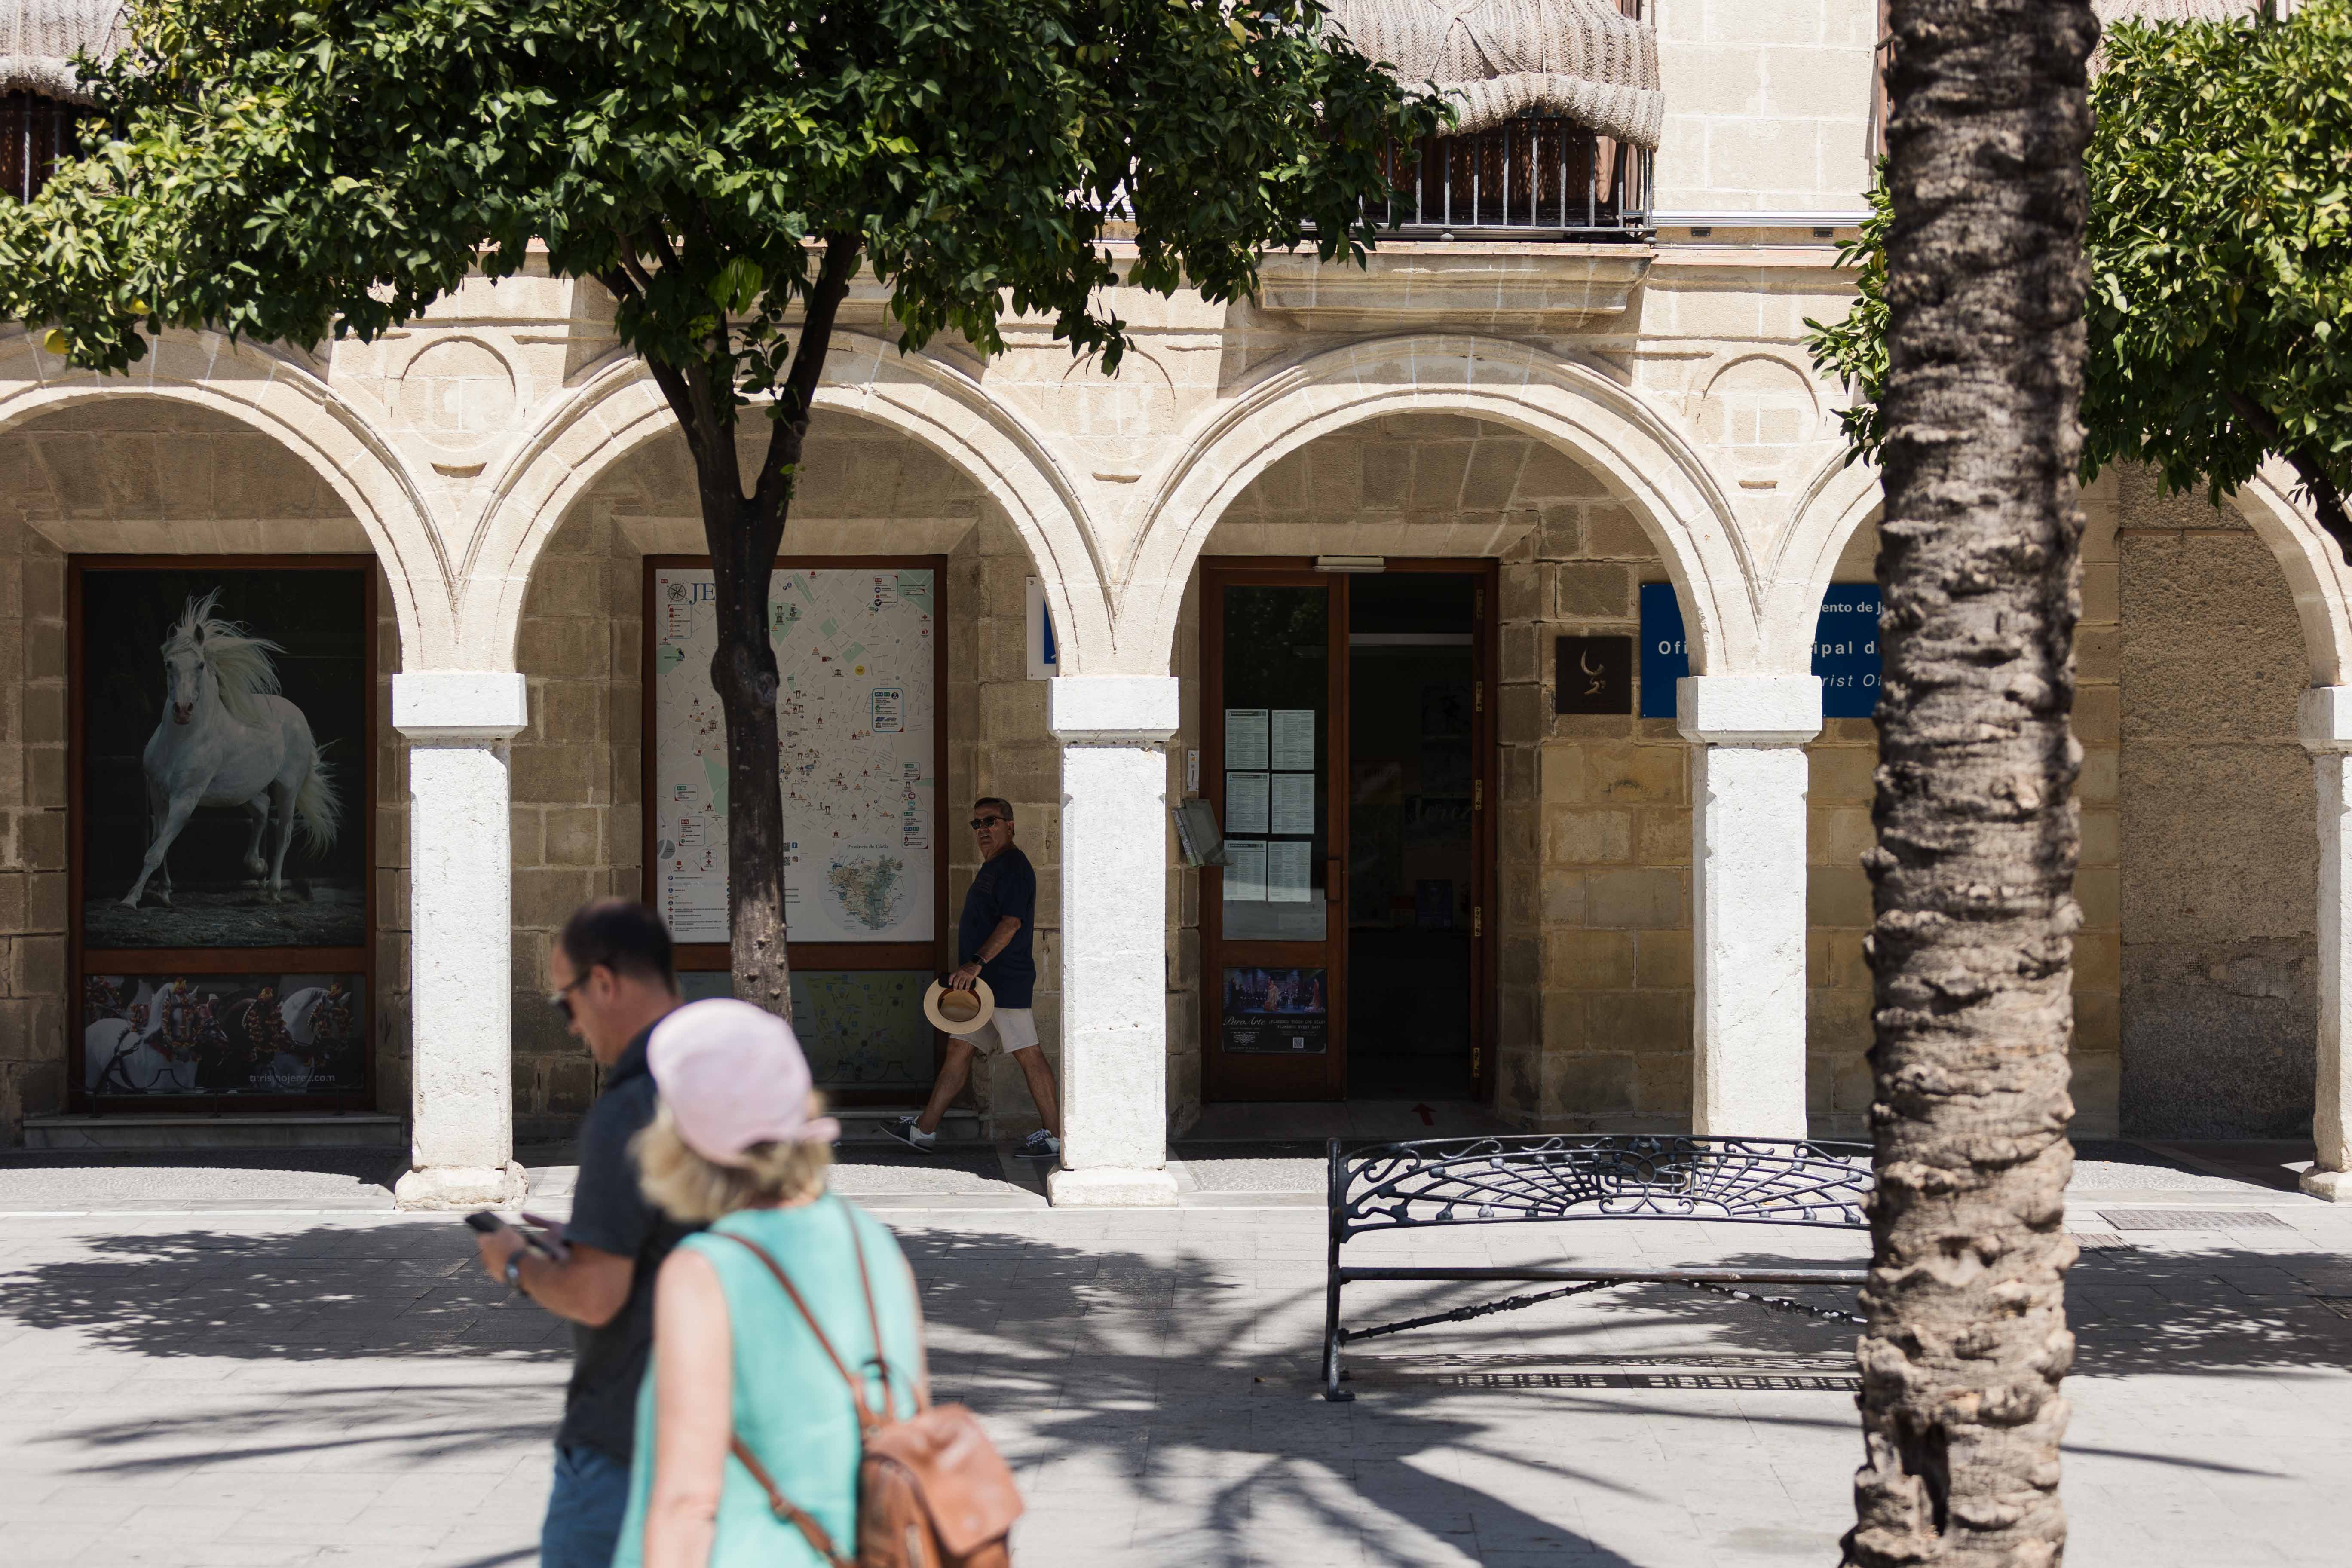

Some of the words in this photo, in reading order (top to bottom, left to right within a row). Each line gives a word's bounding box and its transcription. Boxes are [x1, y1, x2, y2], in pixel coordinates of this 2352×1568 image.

[689, 583, 716, 605] JE
[1821, 602, 1853, 612] ento
[1856, 601, 1873, 612] de
[1876, 601, 1886, 616] Je
[1658, 640, 1687, 655] Ofi
[1813, 640, 1853, 658] ipal
[1864, 640, 1877, 655] d
[1822, 674, 1853, 687] rist
[1223, 1016, 1246, 1025] Puro
